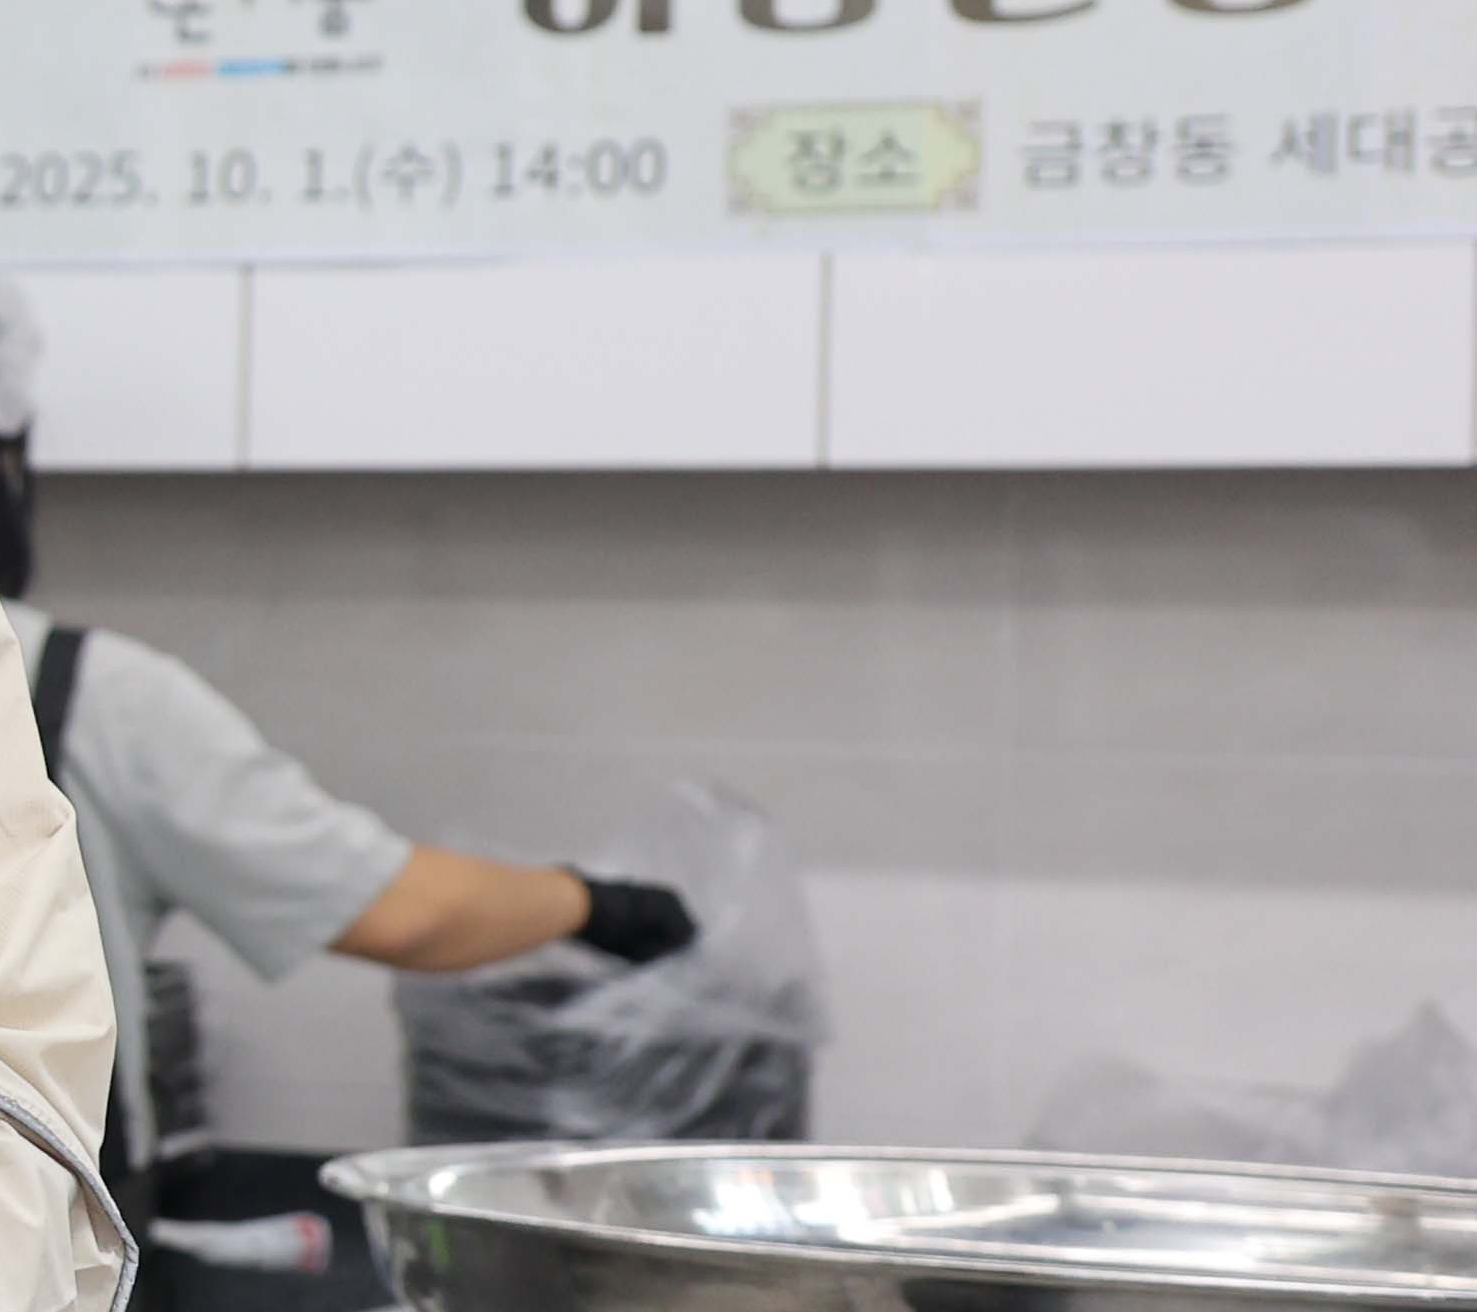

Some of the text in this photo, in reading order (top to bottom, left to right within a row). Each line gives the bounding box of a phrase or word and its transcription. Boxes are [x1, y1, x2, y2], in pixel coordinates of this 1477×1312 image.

[186, 147, 272, 207] 10.
[490, 137, 668, 201] 14:00
[786, 121, 923, 191] 장소
[1023, 114, 1235, 188] 금창동
